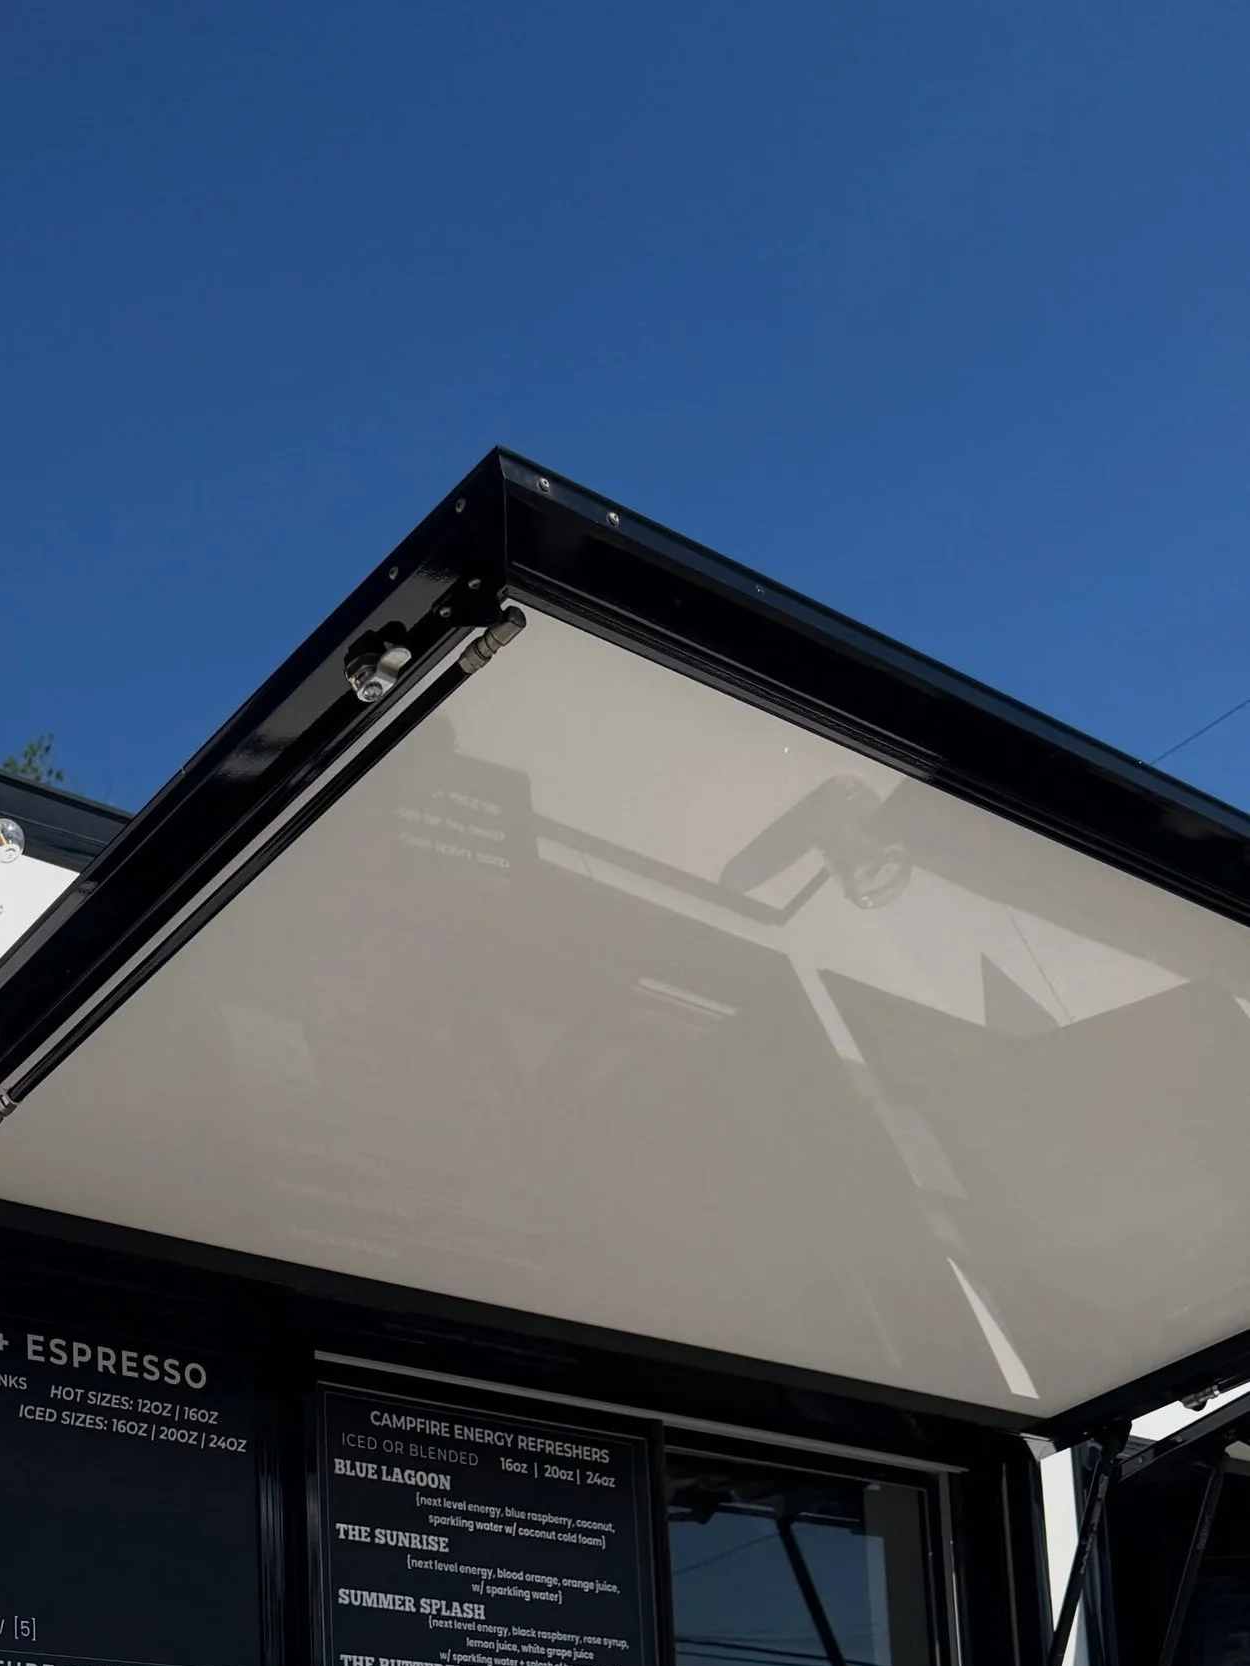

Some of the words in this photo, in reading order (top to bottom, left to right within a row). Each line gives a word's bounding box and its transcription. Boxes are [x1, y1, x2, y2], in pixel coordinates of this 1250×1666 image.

[27, 1334, 206, 1389] ESPRESSO
[50, 1385, 85, 1402] HOT
[87, 1391, 133, 1410] SIZES:
[19, 1404, 57, 1422] ICED
[61, 1411, 108, 1430] SIZES:
[342, 1432, 377, 1450] ICED
[382, 1439, 404, 1454] OR
[409, 1443, 478, 1466] BLENDED
[370, 1411, 450, 1437] CAMPFIRE
[454, 1424, 514, 1447] ENERGY
[518, 1435, 609, 1463] REFRESHERS
[334, 1458, 378, 1480] BLUE
[381, 1465, 451, 1490] LAGOON
[443, 1498, 466, 1511] level
[467, 1504, 504, 1518] energy,
[505, 1506, 526, 1519] blue
[527, 1512, 575, 1529] raspberry,
[576, 1519, 615, 1533] coconut,
[336, 1523, 371, 1542] THE
[375, 1528, 449, 1552] SUNRISE
[338, 1588, 416, 1612] SUMMER
[420, 1598, 485, 1619] SPLASH
[14, 1615, 36, 1641] [5]
